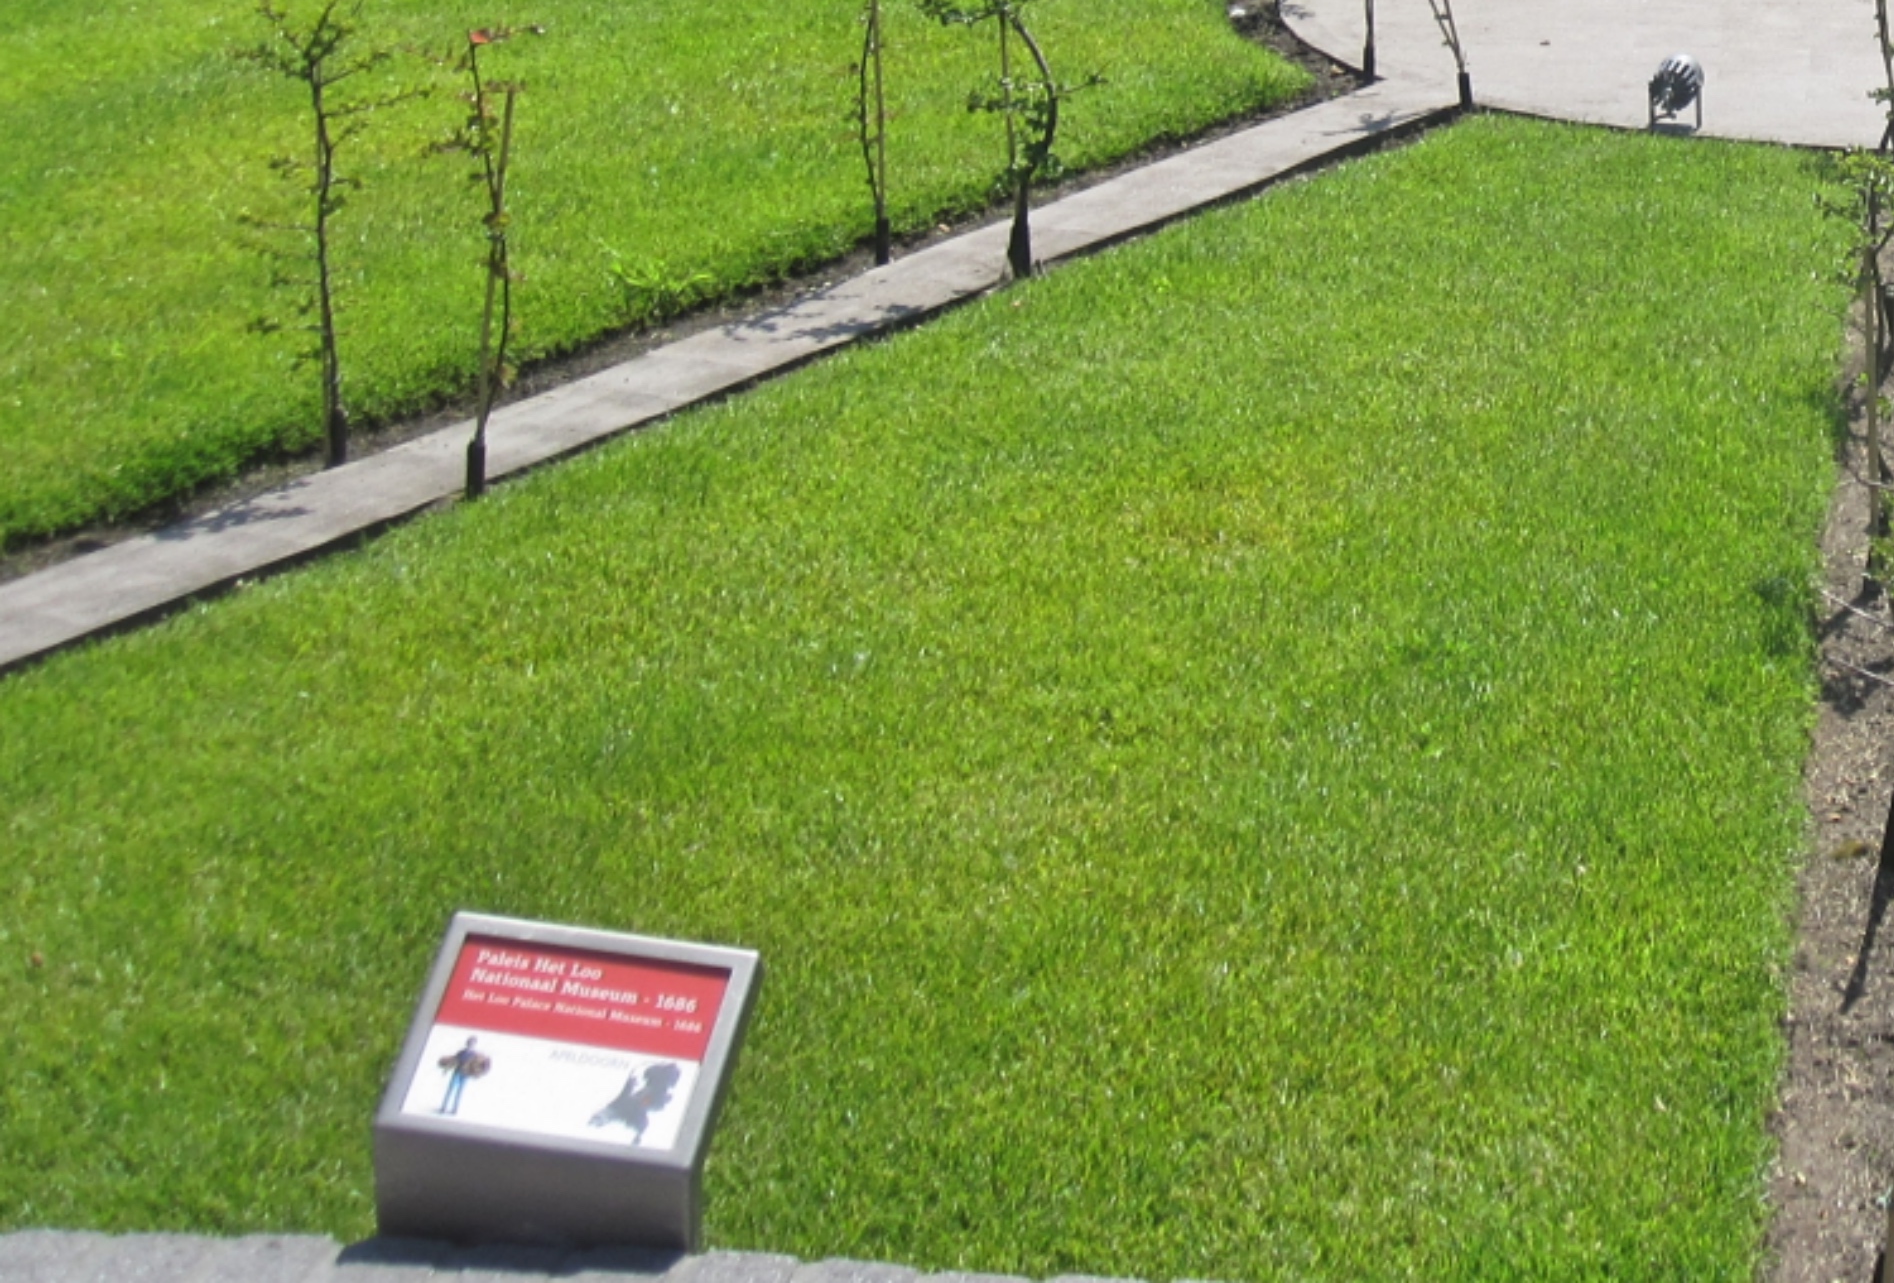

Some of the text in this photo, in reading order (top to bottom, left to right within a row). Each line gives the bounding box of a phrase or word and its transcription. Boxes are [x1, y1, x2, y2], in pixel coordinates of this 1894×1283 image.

[477, 949, 602, 980] Paleis Het Loo
[462, 989, 486, 1002] Het
[487, 991, 510, 1005] Loo
[512, 995, 551, 1011] Palace
[554, 1002, 607, 1019] National
[609, 1010, 662, 1027] Museum
[470, 968, 557, 994] Nationaal
[561, 979, 638, 1004] Museum
[655, 994, 698, 1013] 1686
